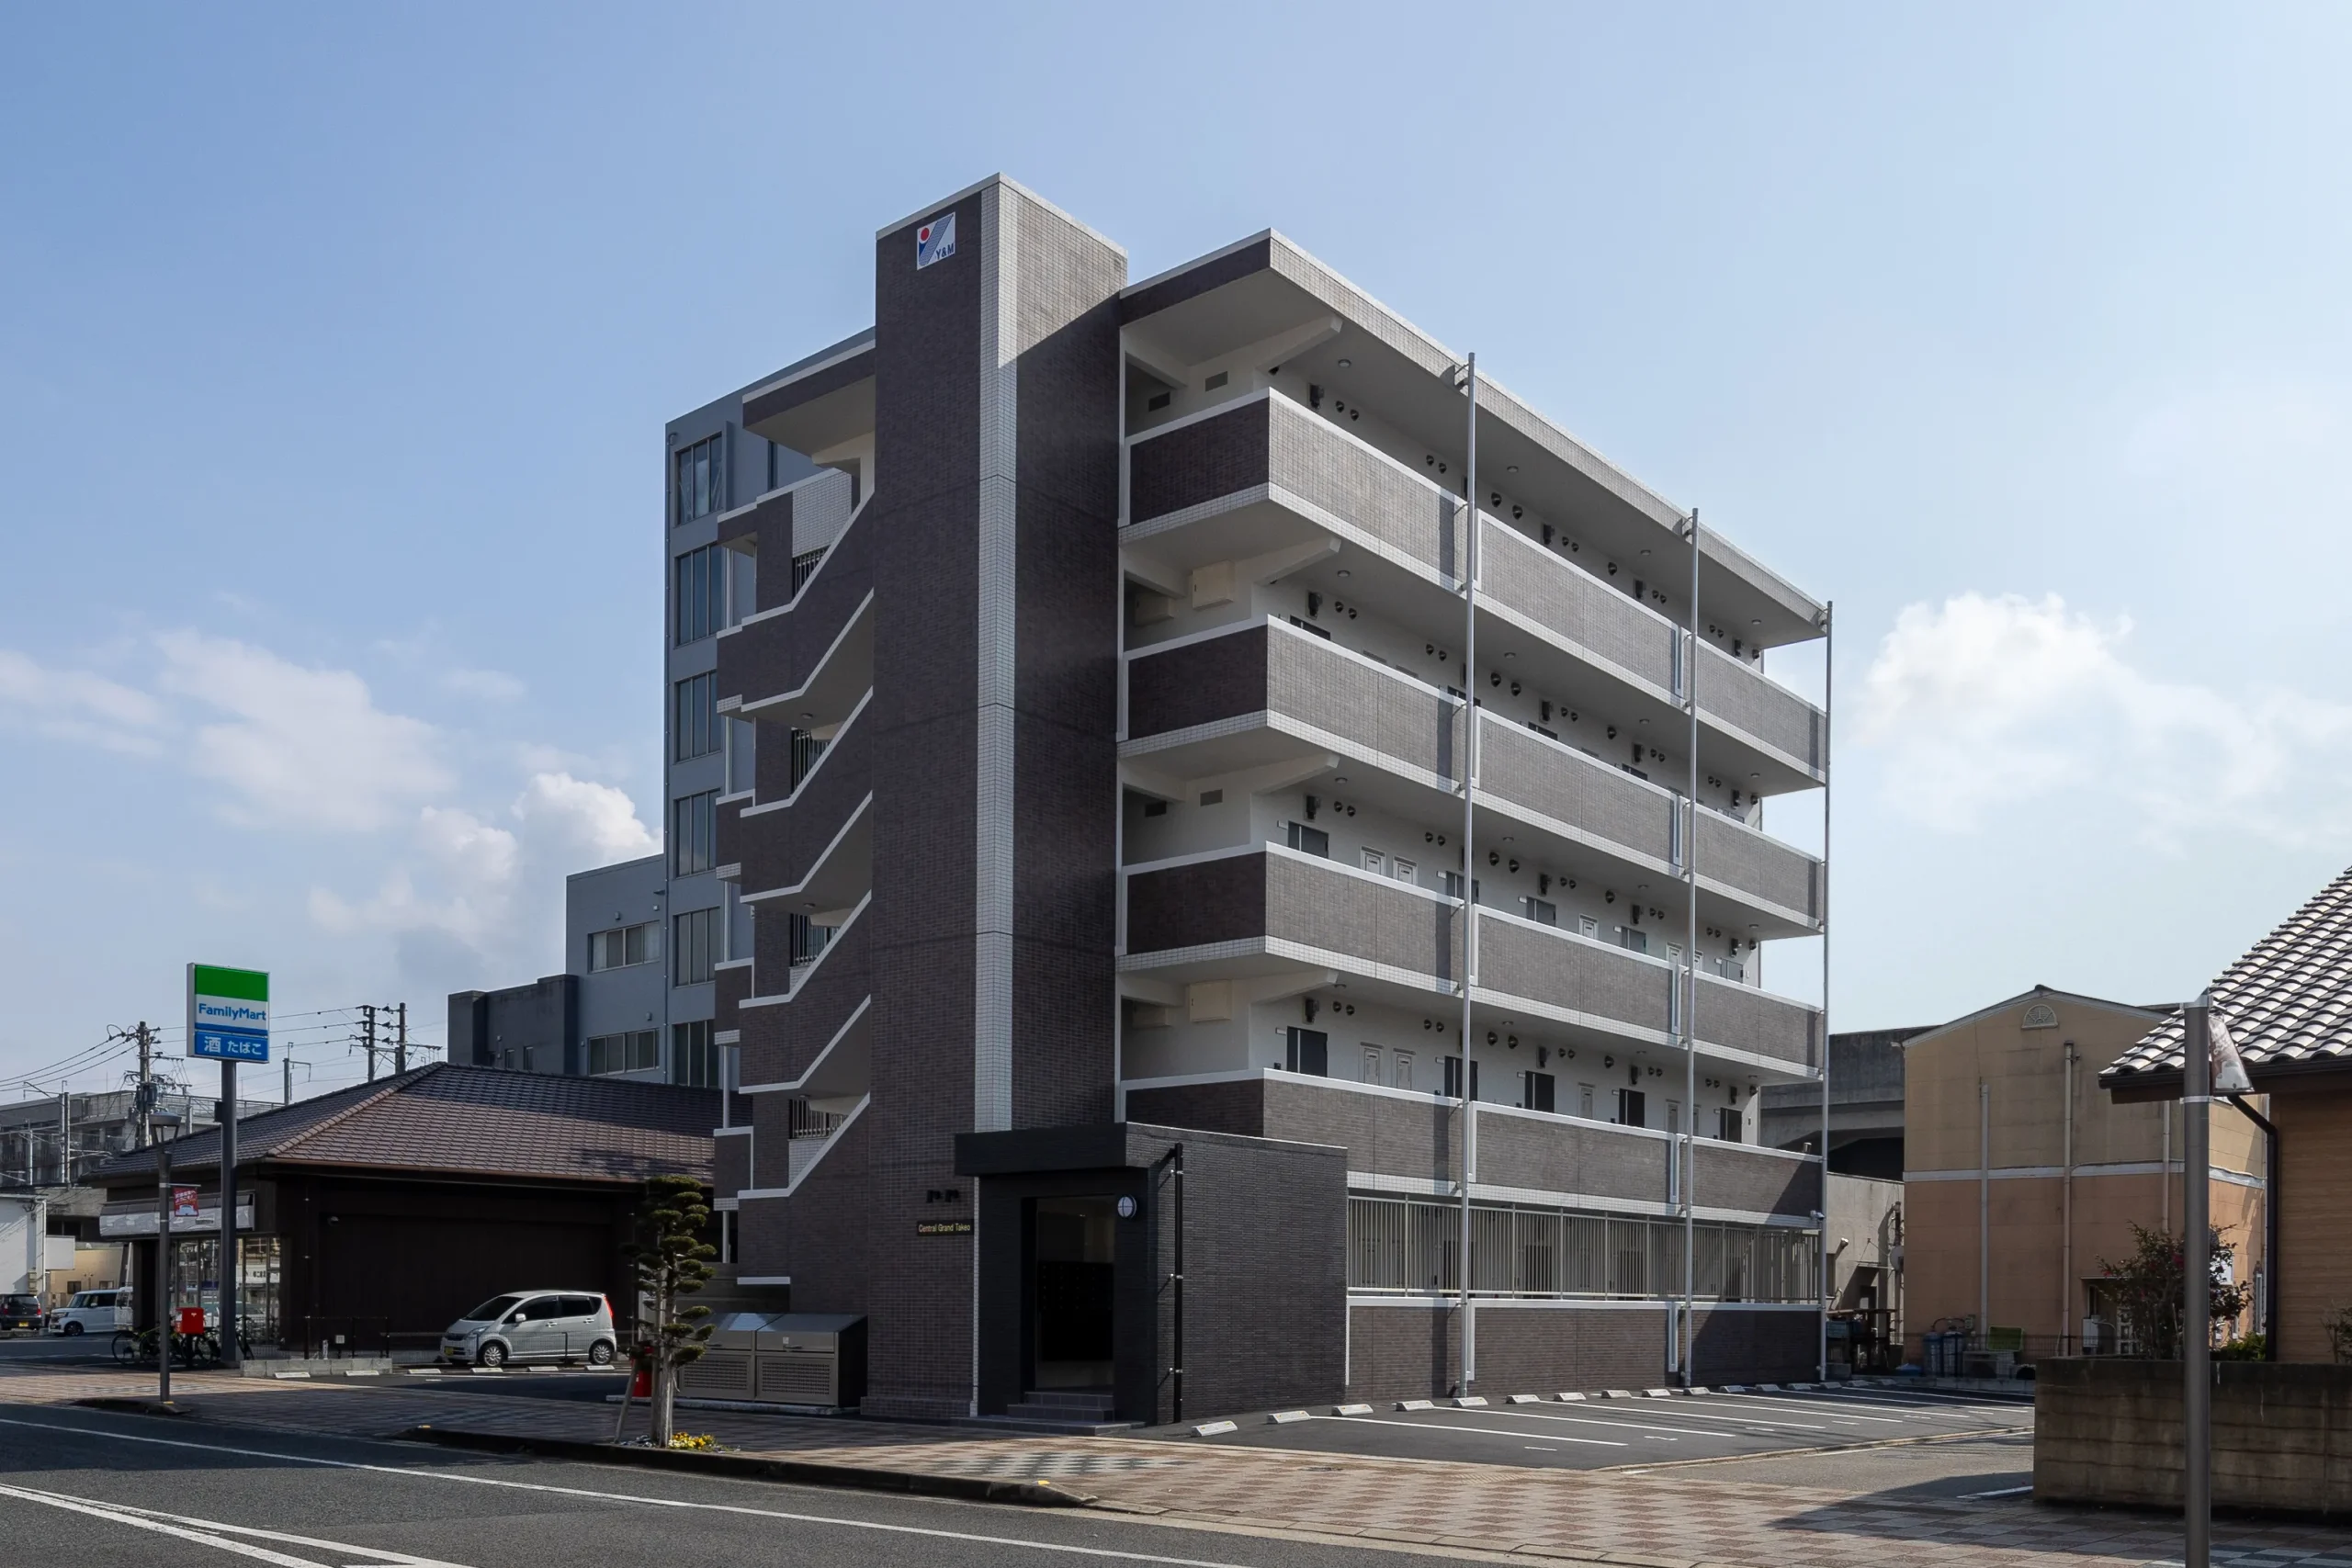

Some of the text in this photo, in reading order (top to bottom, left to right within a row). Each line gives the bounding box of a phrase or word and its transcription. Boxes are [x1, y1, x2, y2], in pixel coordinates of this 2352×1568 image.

[935, 243, 954, 260] Y&M
[198, 1003, 266, 1021] FamilyMart
[204, 1036, 262, 1055] 酒 たばこ
[918, 1223, 971, 1233] Central Grand Takeo
